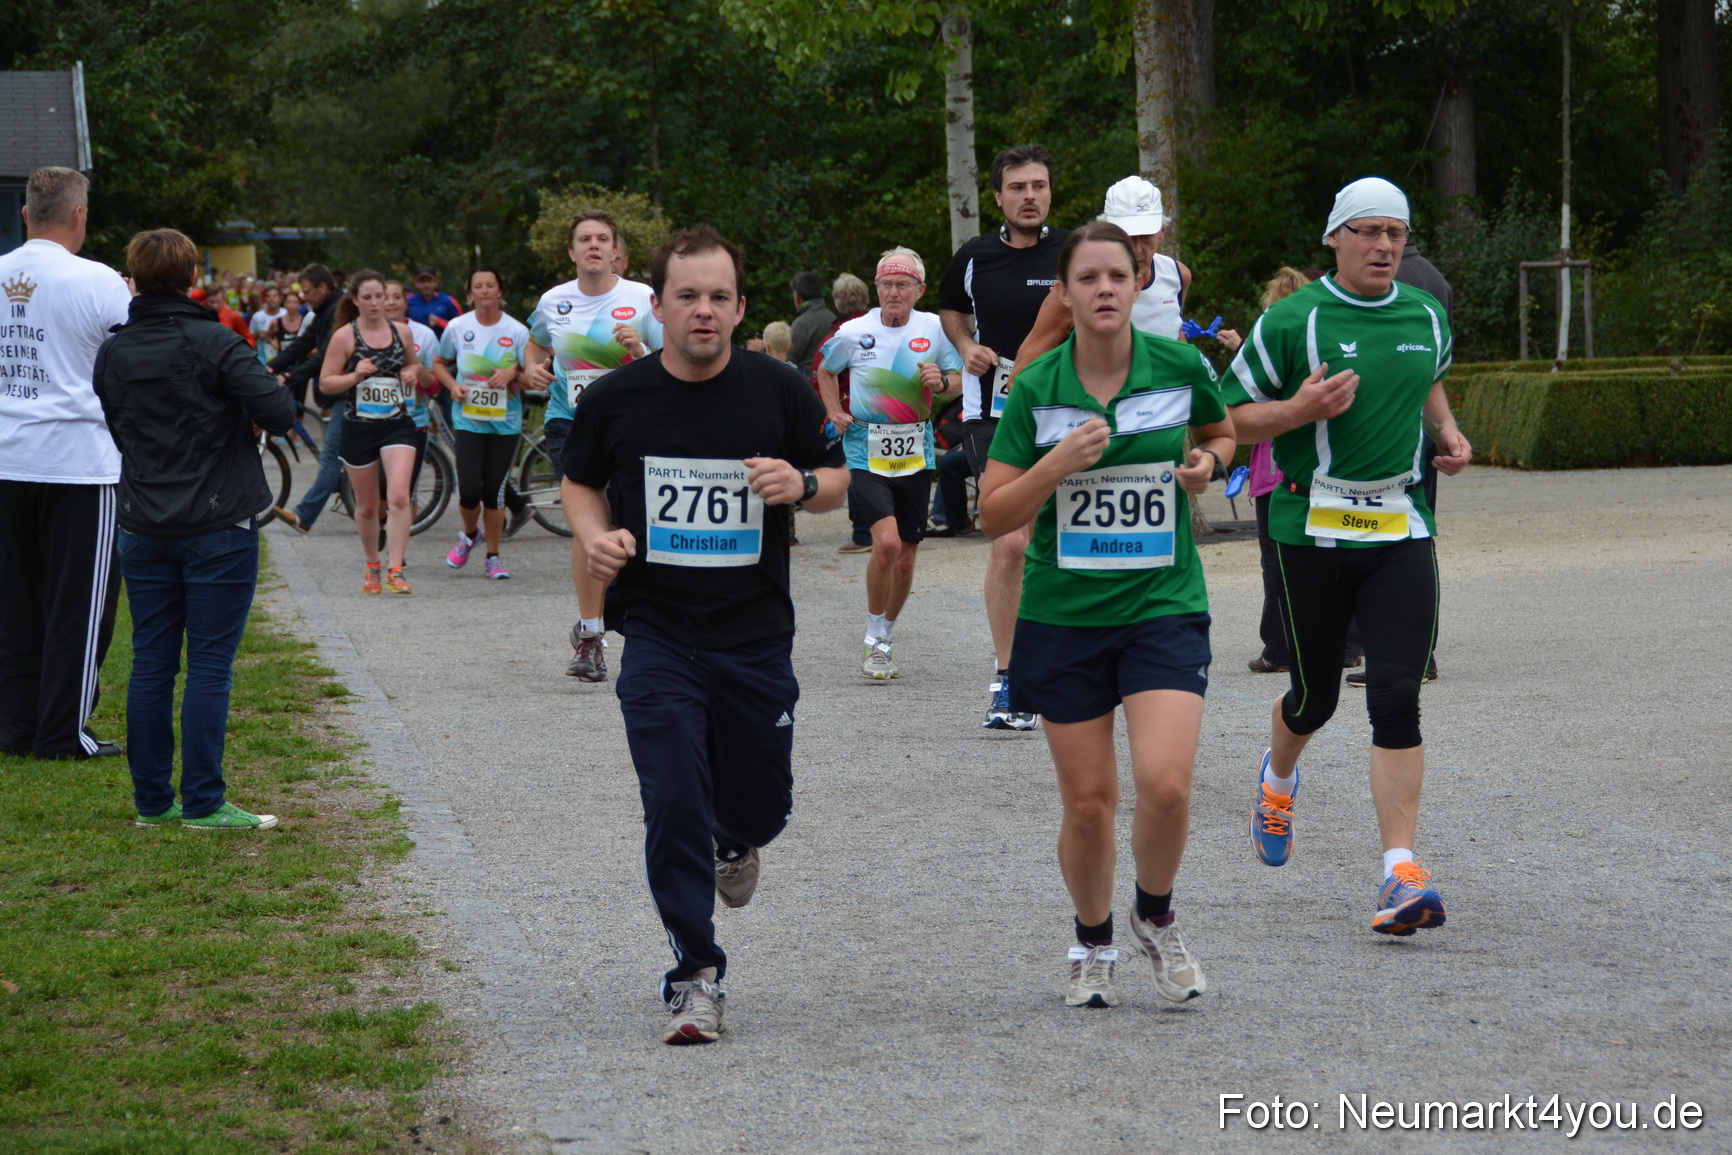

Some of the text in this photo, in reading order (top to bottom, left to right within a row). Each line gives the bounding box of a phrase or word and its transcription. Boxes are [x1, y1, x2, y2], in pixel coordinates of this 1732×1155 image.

[11, 304, 26, 318] IM
[0, 344, 38, 361] SEINER
[997, 361, 1014, 371] PART
[5, 383, 38, 400] JESUS
[362, 386, 399, 404] 3096
[471, 390, 499, 407] 250
[890, 428, 917, 436] Neumarkt
[881, 436, 915, 457] 332
[648, 466, 745, 480] PARTL Neumarkt
[888, 460, 906, 470] Willi
[1059, 474, 1157, 487] PARTL Neumarkt
[1314, 478, 1395, 496] PARTL Neumarkt
[658, 484, 749, 525] 2761
[1070, 488, 1166, 528] 2596
[1341, 513, 1379, 530] Steve
[670, 533, 737, 551] Christian
[1089, 537, 1143, 554] Andrea
